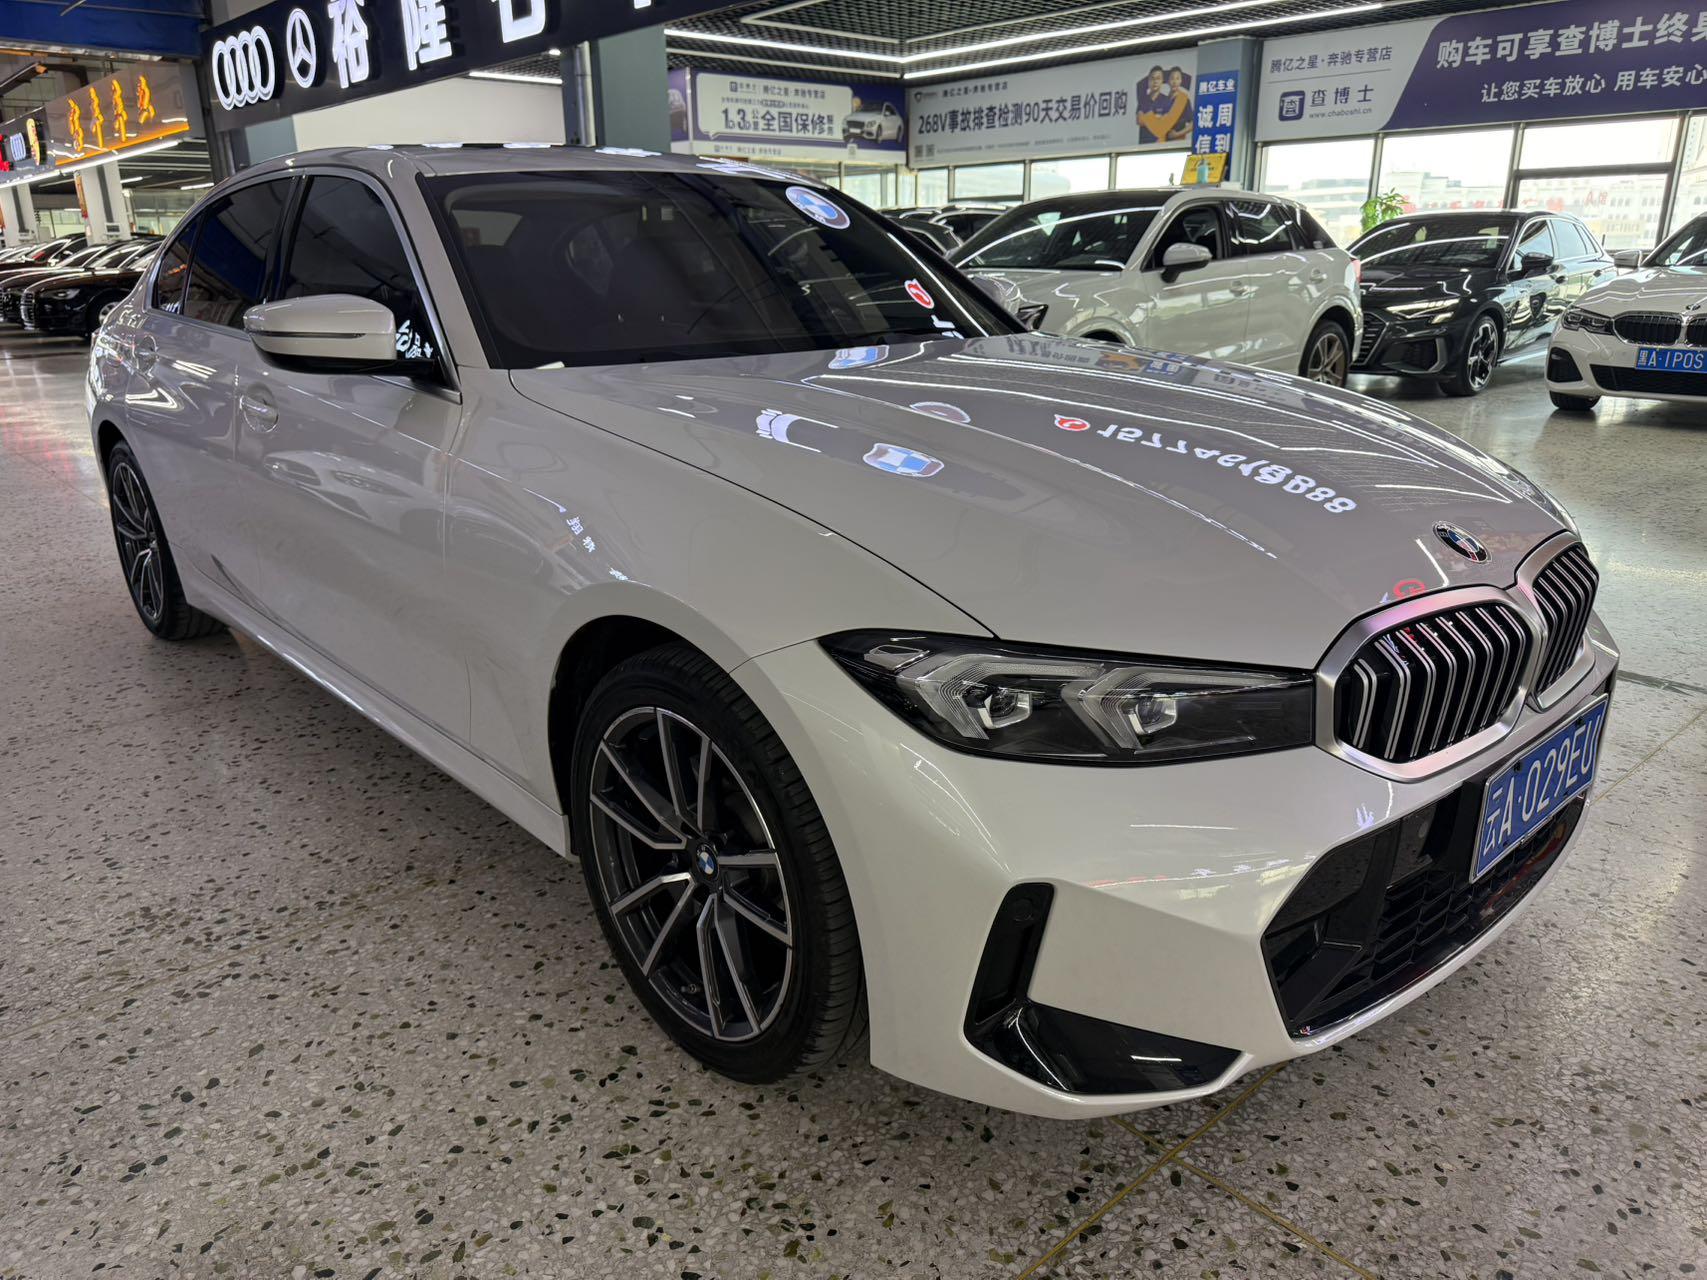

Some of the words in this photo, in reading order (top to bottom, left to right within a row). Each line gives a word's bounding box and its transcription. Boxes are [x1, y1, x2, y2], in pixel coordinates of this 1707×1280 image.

[1481, 73, 1606, 103] 让您买车放心
[917, 91, 1129, 135] 268V事故排查检测90天交易价回购
